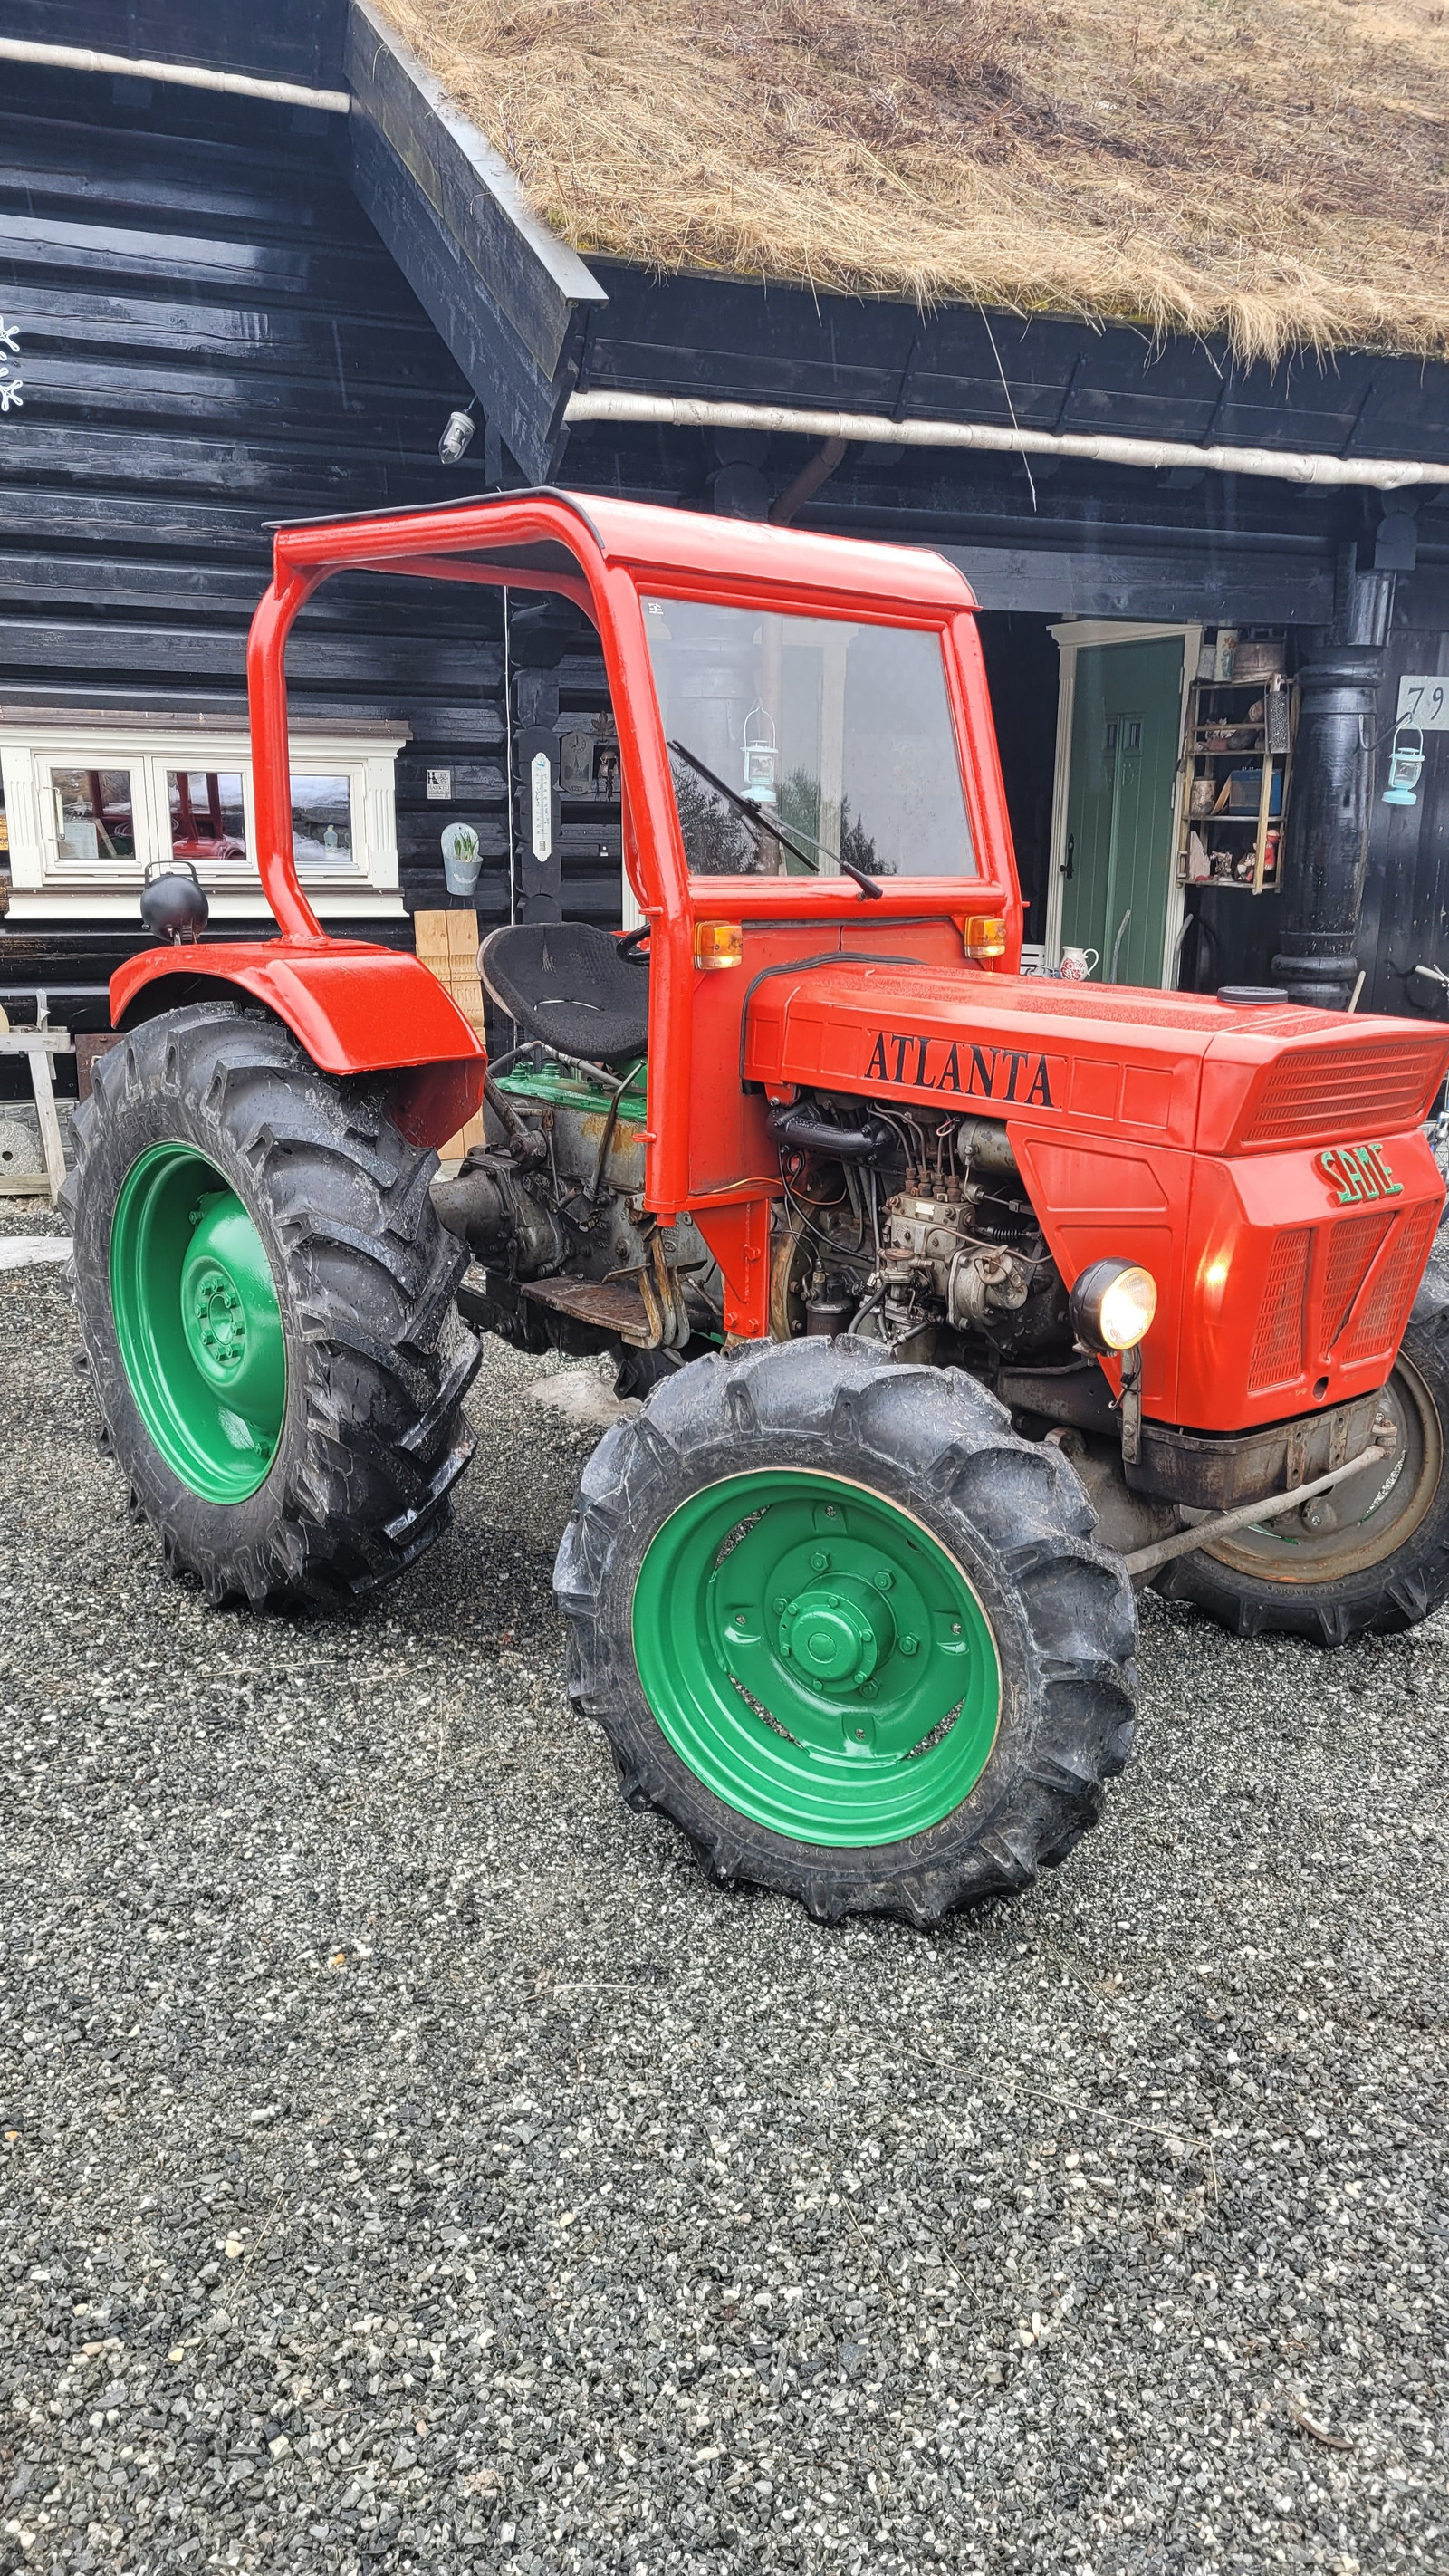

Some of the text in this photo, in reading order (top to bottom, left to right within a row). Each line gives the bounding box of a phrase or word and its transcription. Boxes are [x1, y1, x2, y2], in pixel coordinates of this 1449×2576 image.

[1407, 686, 1444, 722] 79
[863, 1031, 1055, 1108] ATLANTA
[1318, 1142, 1403, 1206] SAME
